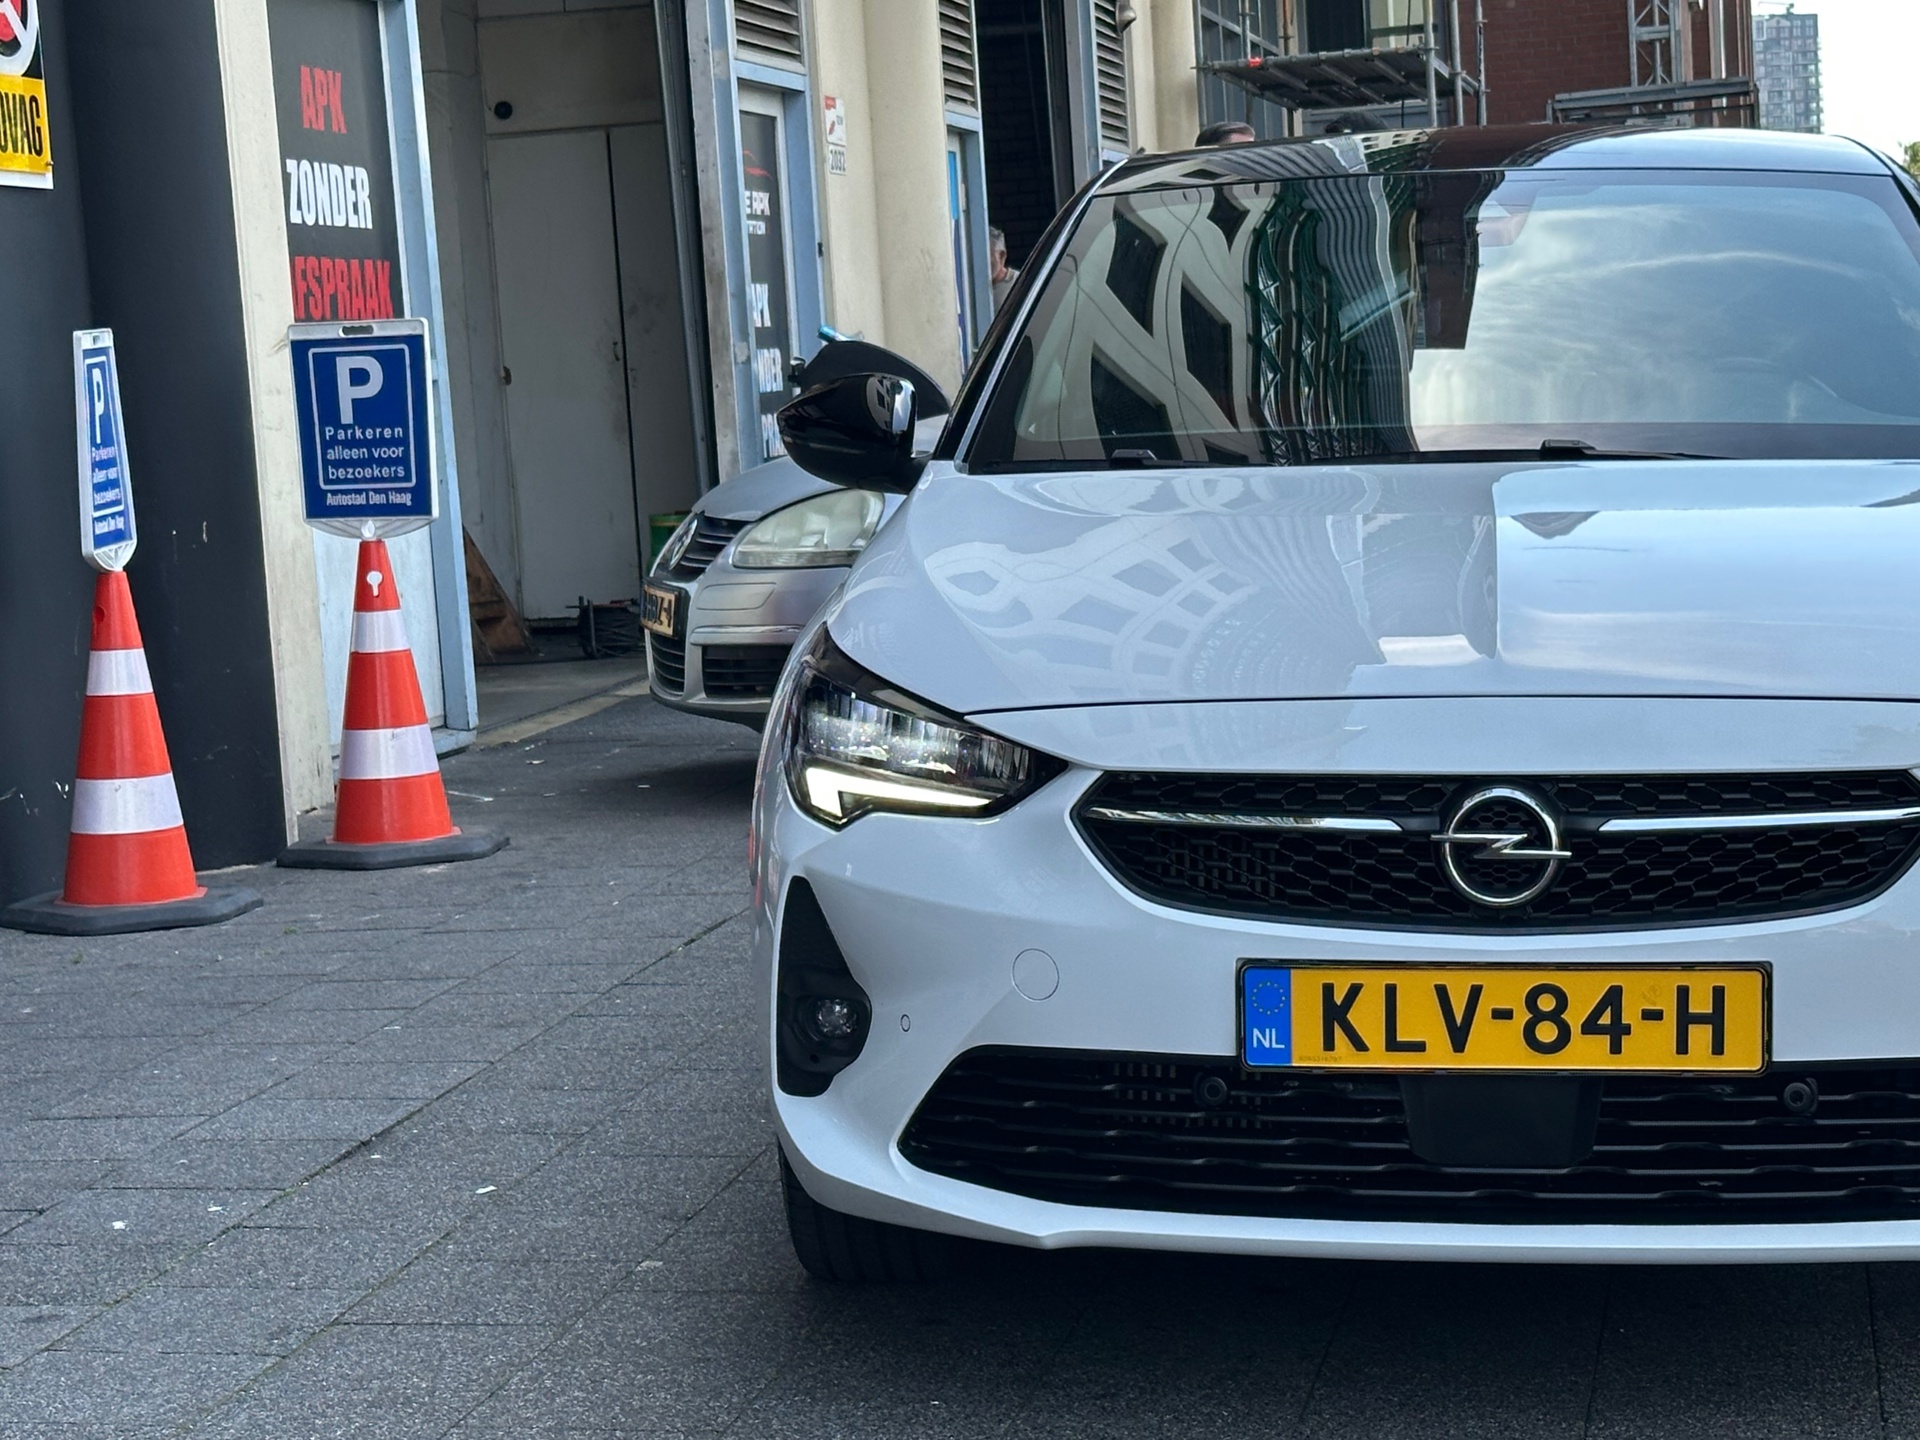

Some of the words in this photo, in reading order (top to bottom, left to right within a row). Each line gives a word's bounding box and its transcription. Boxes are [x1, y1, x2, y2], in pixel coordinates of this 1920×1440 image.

[300, 65, 347, 134] APK
[286, 158, 373, 229] ZONDER
[293, 255, 394, 320] FSPRAAK
[92, 367, 104, 444] P
[335, 355, 384, 425] P
[325, 426, 403, 441] Parkeren
[326, 445, 368, 460] alleen
[371, 446, 404, 459] voor
[326, 492, 367, 506] Autostad
[368, 491, 387, 504] Den
[388, 491, 412, 507] Haag
[328, 464, 405, 480] bezoekers
[1252, 1027, 1285, 1049] NL
[1321, 982, 1726, 1056] KLV-84-H
